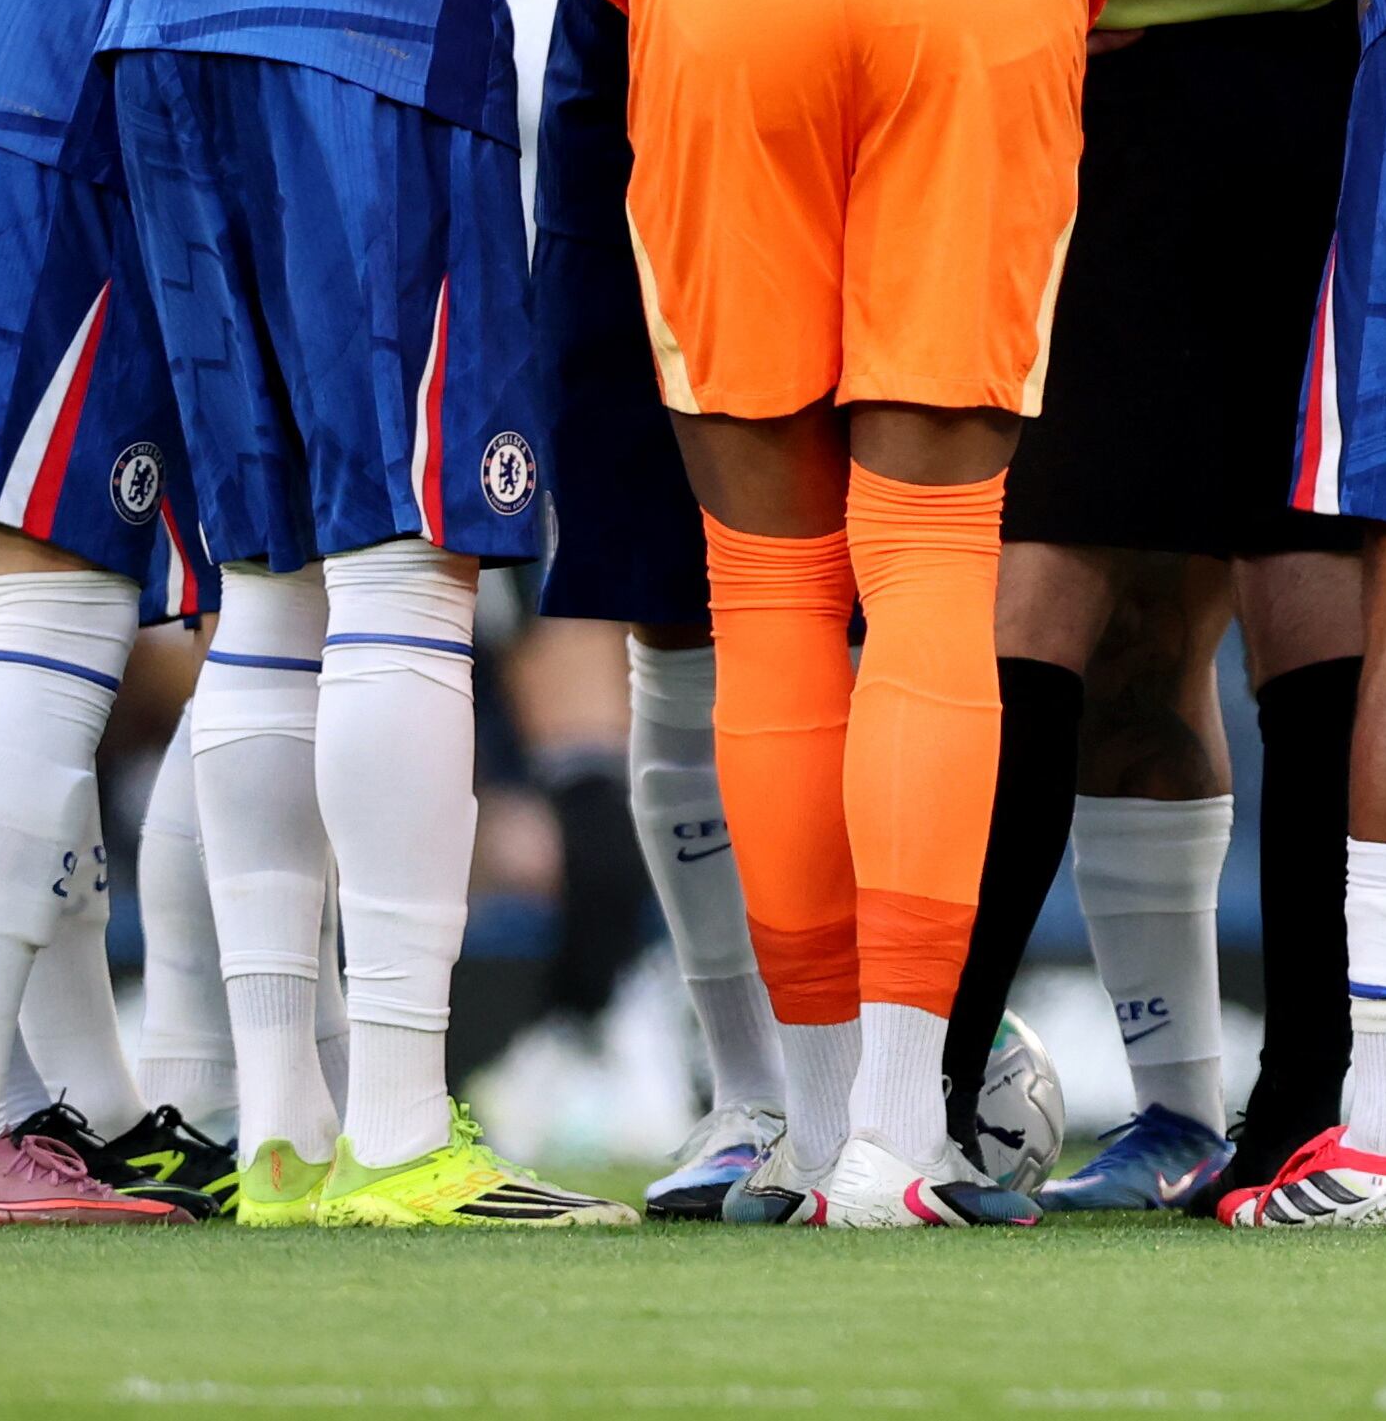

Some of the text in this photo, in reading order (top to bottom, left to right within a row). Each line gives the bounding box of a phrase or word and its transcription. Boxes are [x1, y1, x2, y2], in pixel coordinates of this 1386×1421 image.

[492, 434, 527, 455] CHELSEA
[673, 819, 728, 840] CF
[1115, 996, 1170, 1022] CFC
